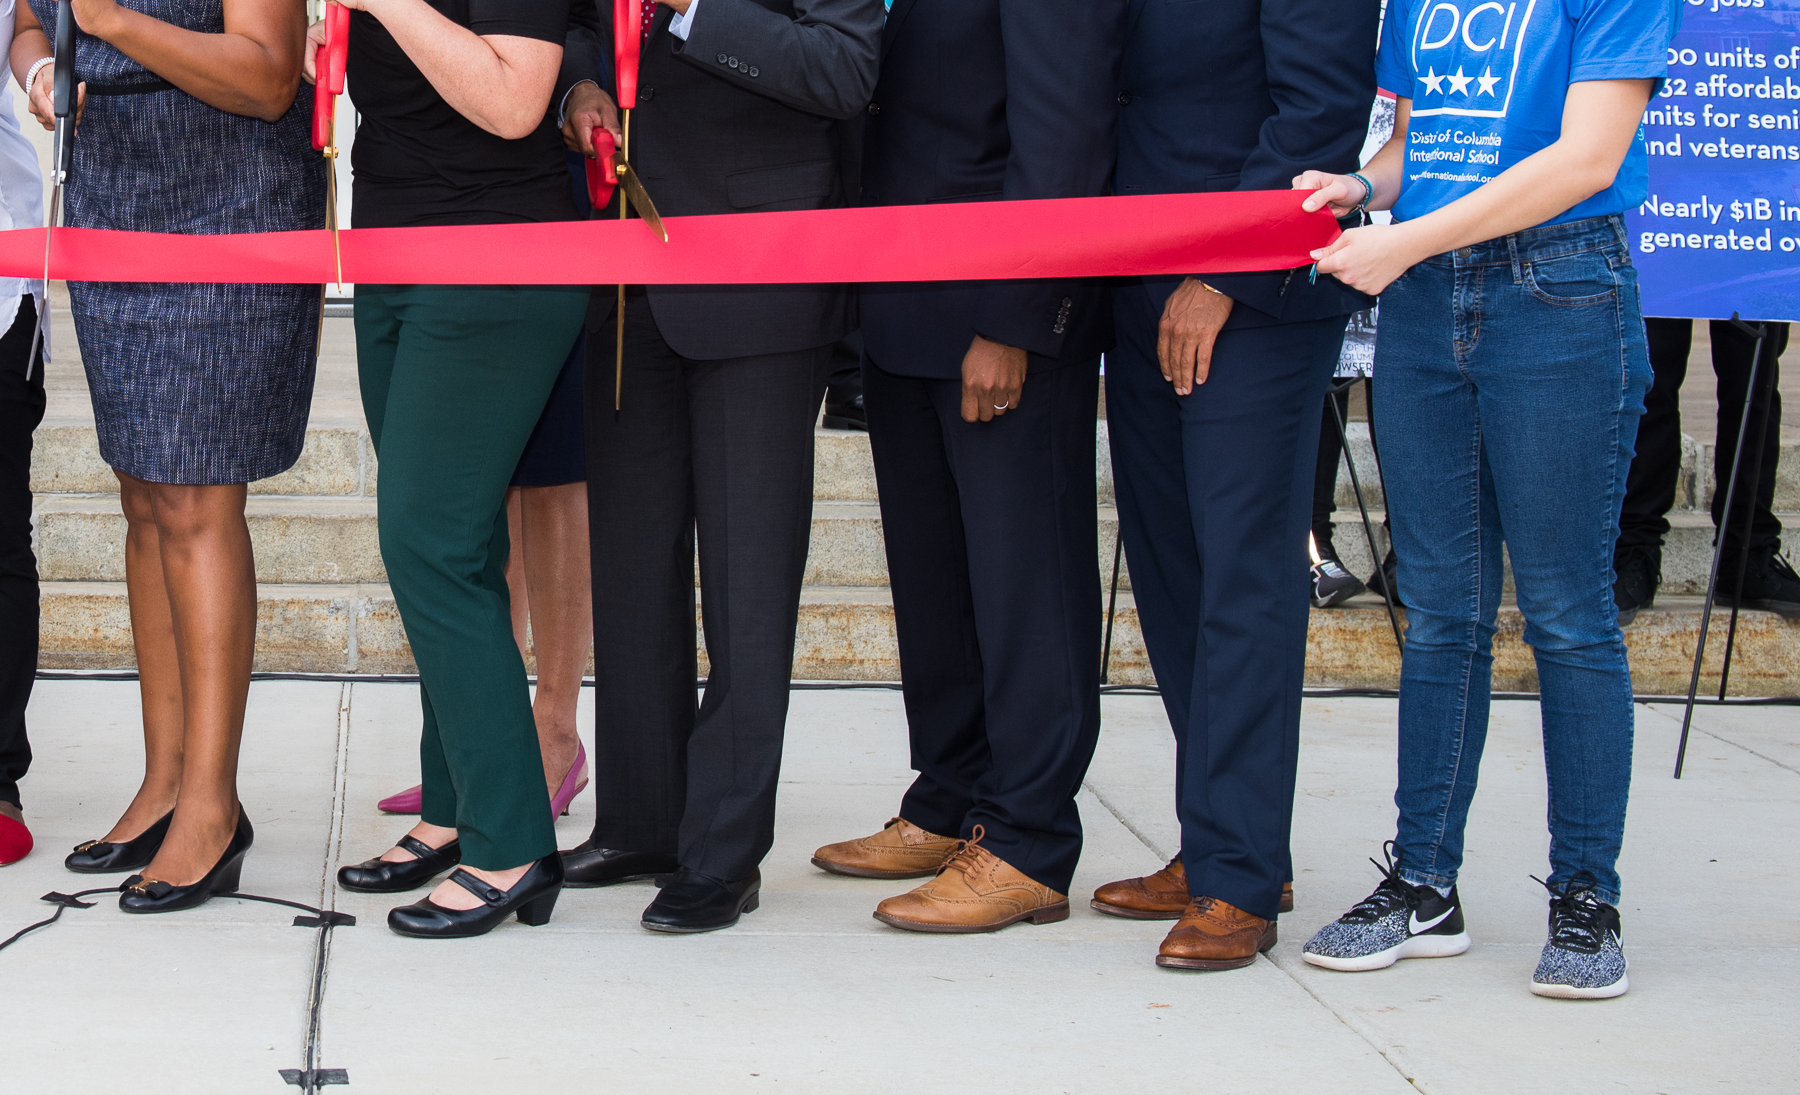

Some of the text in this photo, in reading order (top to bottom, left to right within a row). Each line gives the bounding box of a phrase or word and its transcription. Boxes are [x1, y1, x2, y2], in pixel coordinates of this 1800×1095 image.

[1420, 2, 1516, 52] DCI
[1705, 47, 1767, 68] units
[1774, 46, 1800, 69] of
[1703, 104, 1741, 127] for
[1748, 109, 1800, 130] seni
[1438, 129, 1451, 142] of
[1689, 137, 1800, 160] veterans
[1639, 194, 1723, 225] Nearly
[1730, 199, 1773, 223] $1B
[1639, 228, 1772, 253] generated
